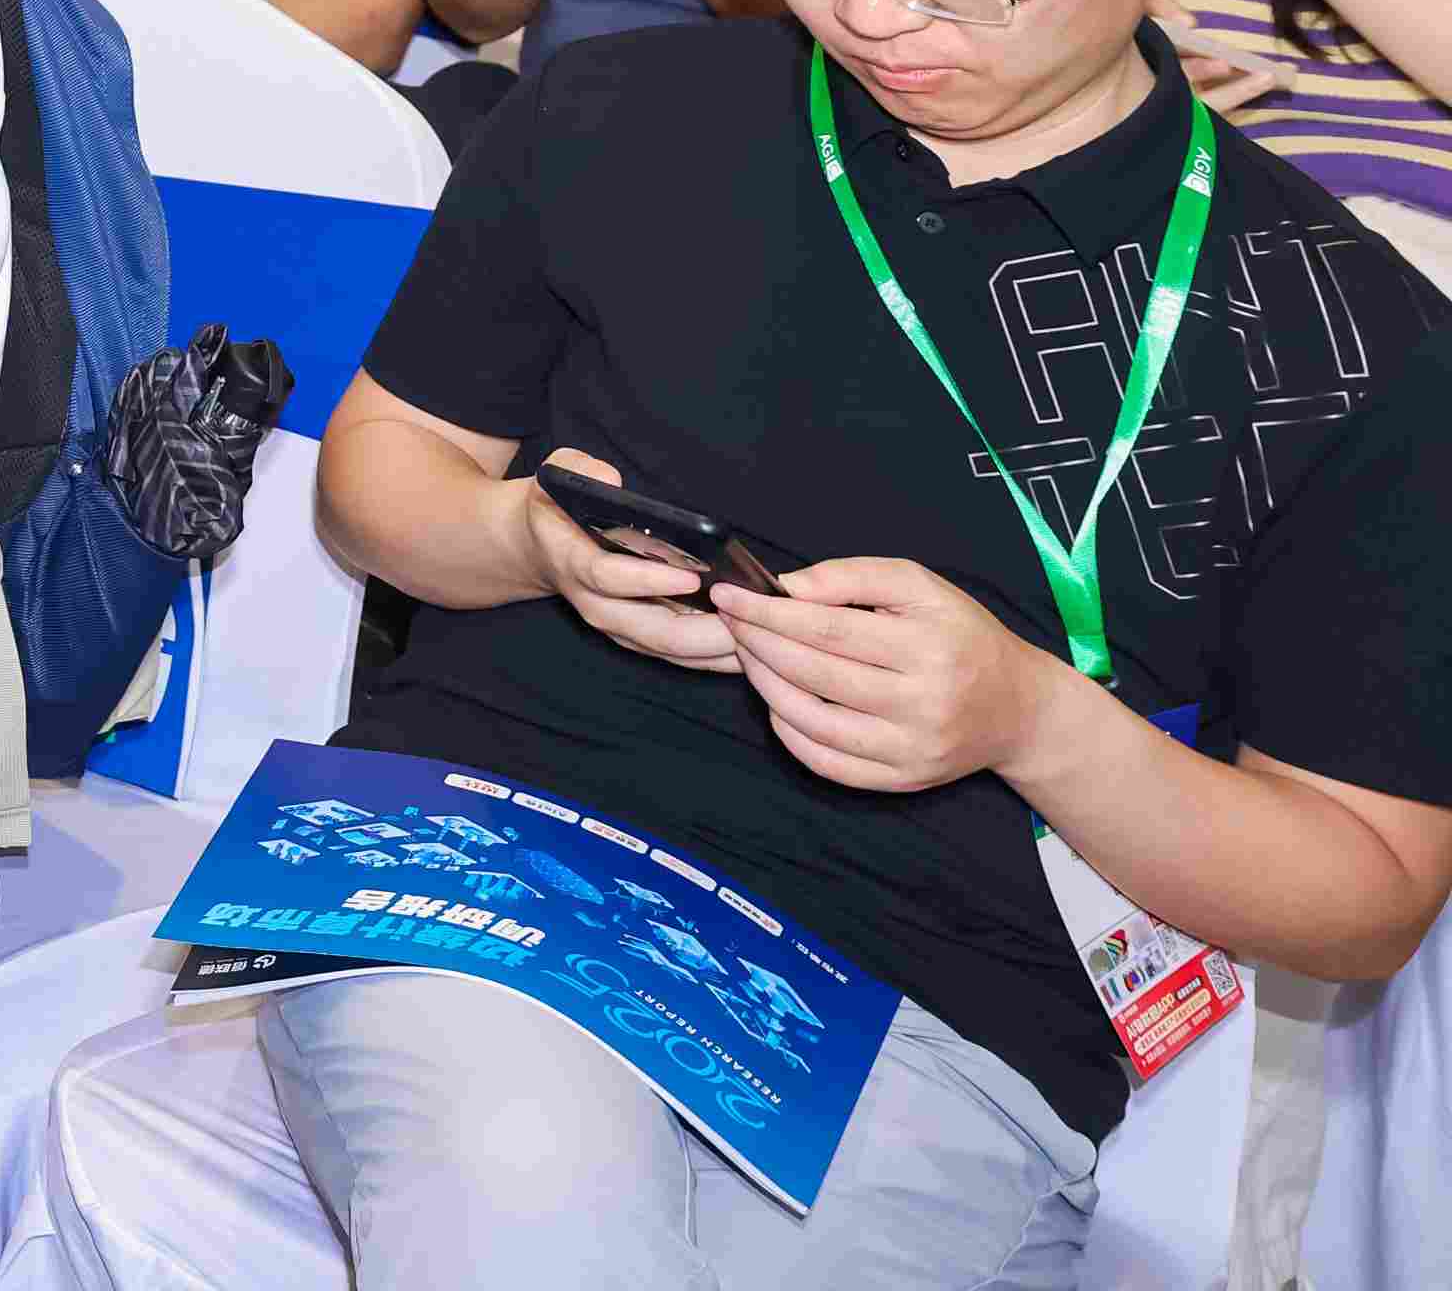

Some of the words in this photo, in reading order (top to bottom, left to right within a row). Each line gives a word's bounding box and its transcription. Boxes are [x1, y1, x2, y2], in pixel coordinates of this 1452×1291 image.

[200, 902, 535, 968] 边缘计算市场
[344, 888, 546, 947] 调研报告
[540, 953, 781, 1129] 2025
[634, 988, 698, 1035] REPORT
[700, 1035, 782, 1105] RESEARCH
